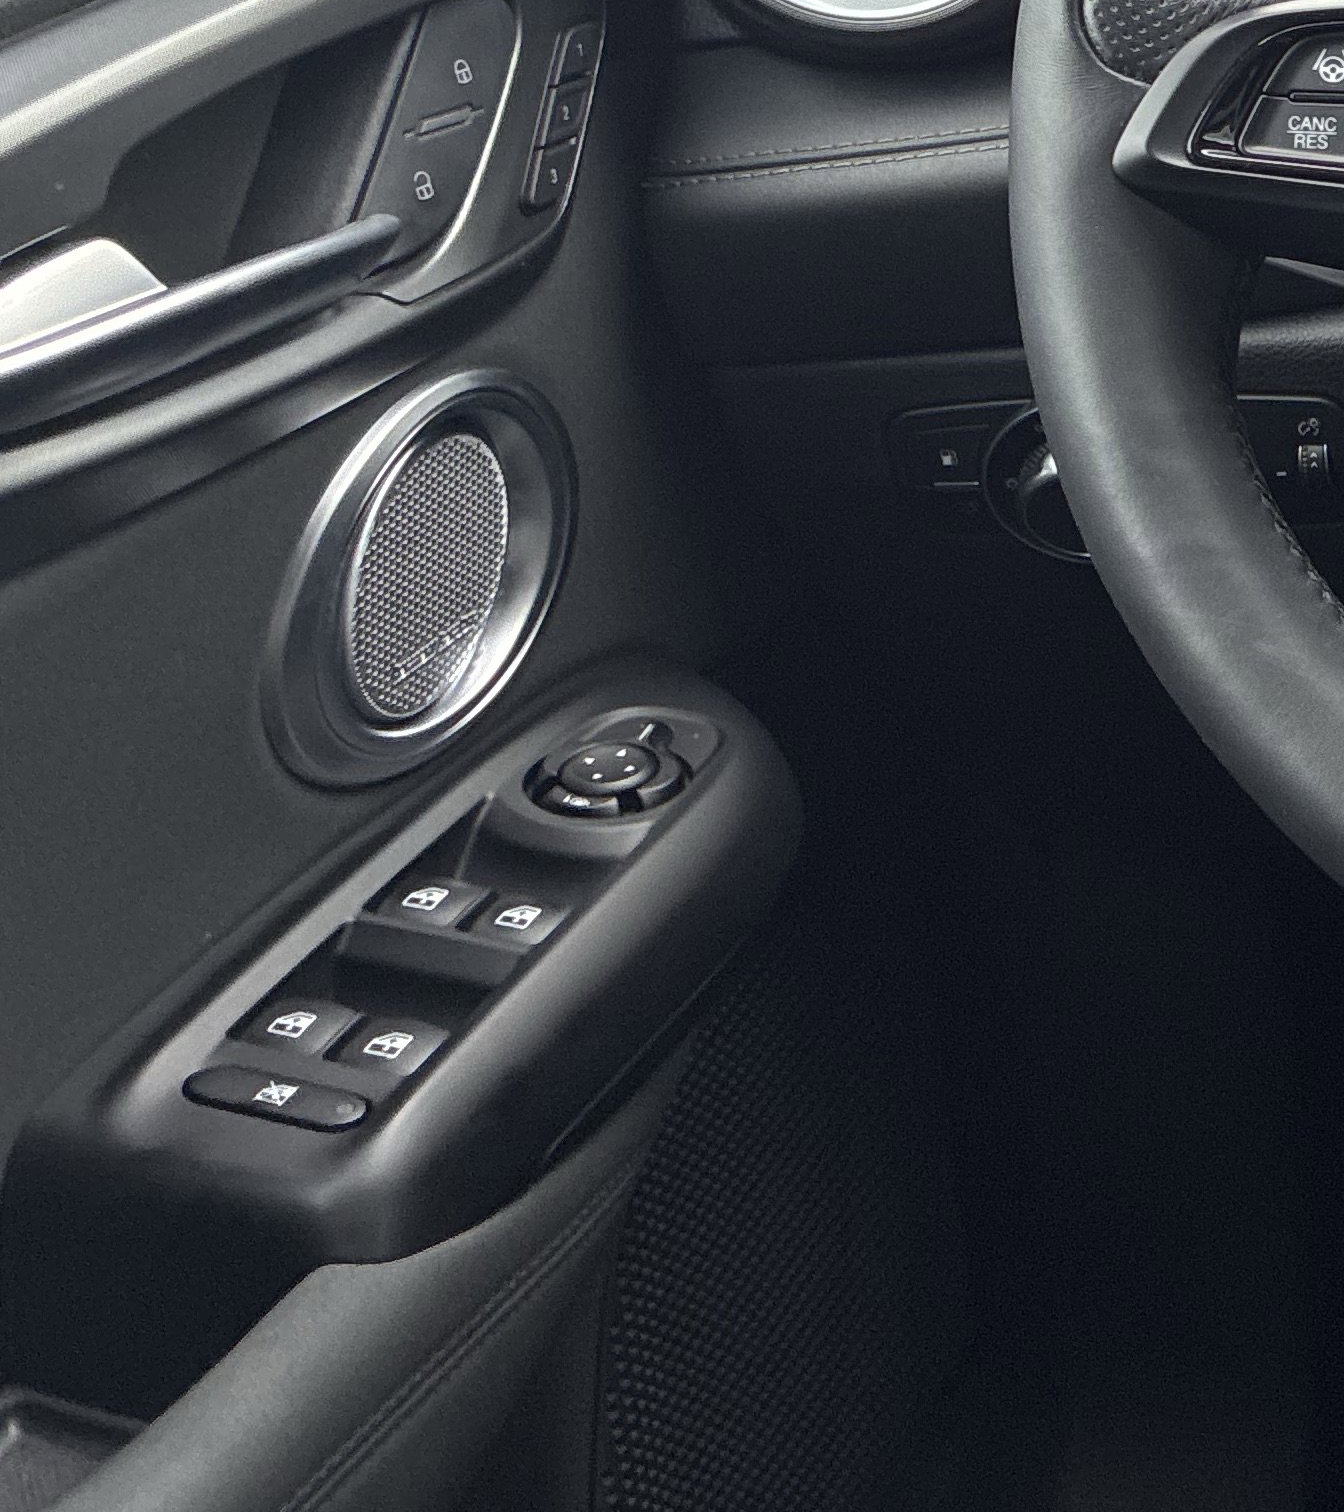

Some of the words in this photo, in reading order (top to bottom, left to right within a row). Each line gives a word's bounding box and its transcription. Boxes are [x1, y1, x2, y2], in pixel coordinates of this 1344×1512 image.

[562, 105, 570, 121] 2
[1287, 117, 1337, 132] CANC
[1293, 134, 1329, 150] RES
